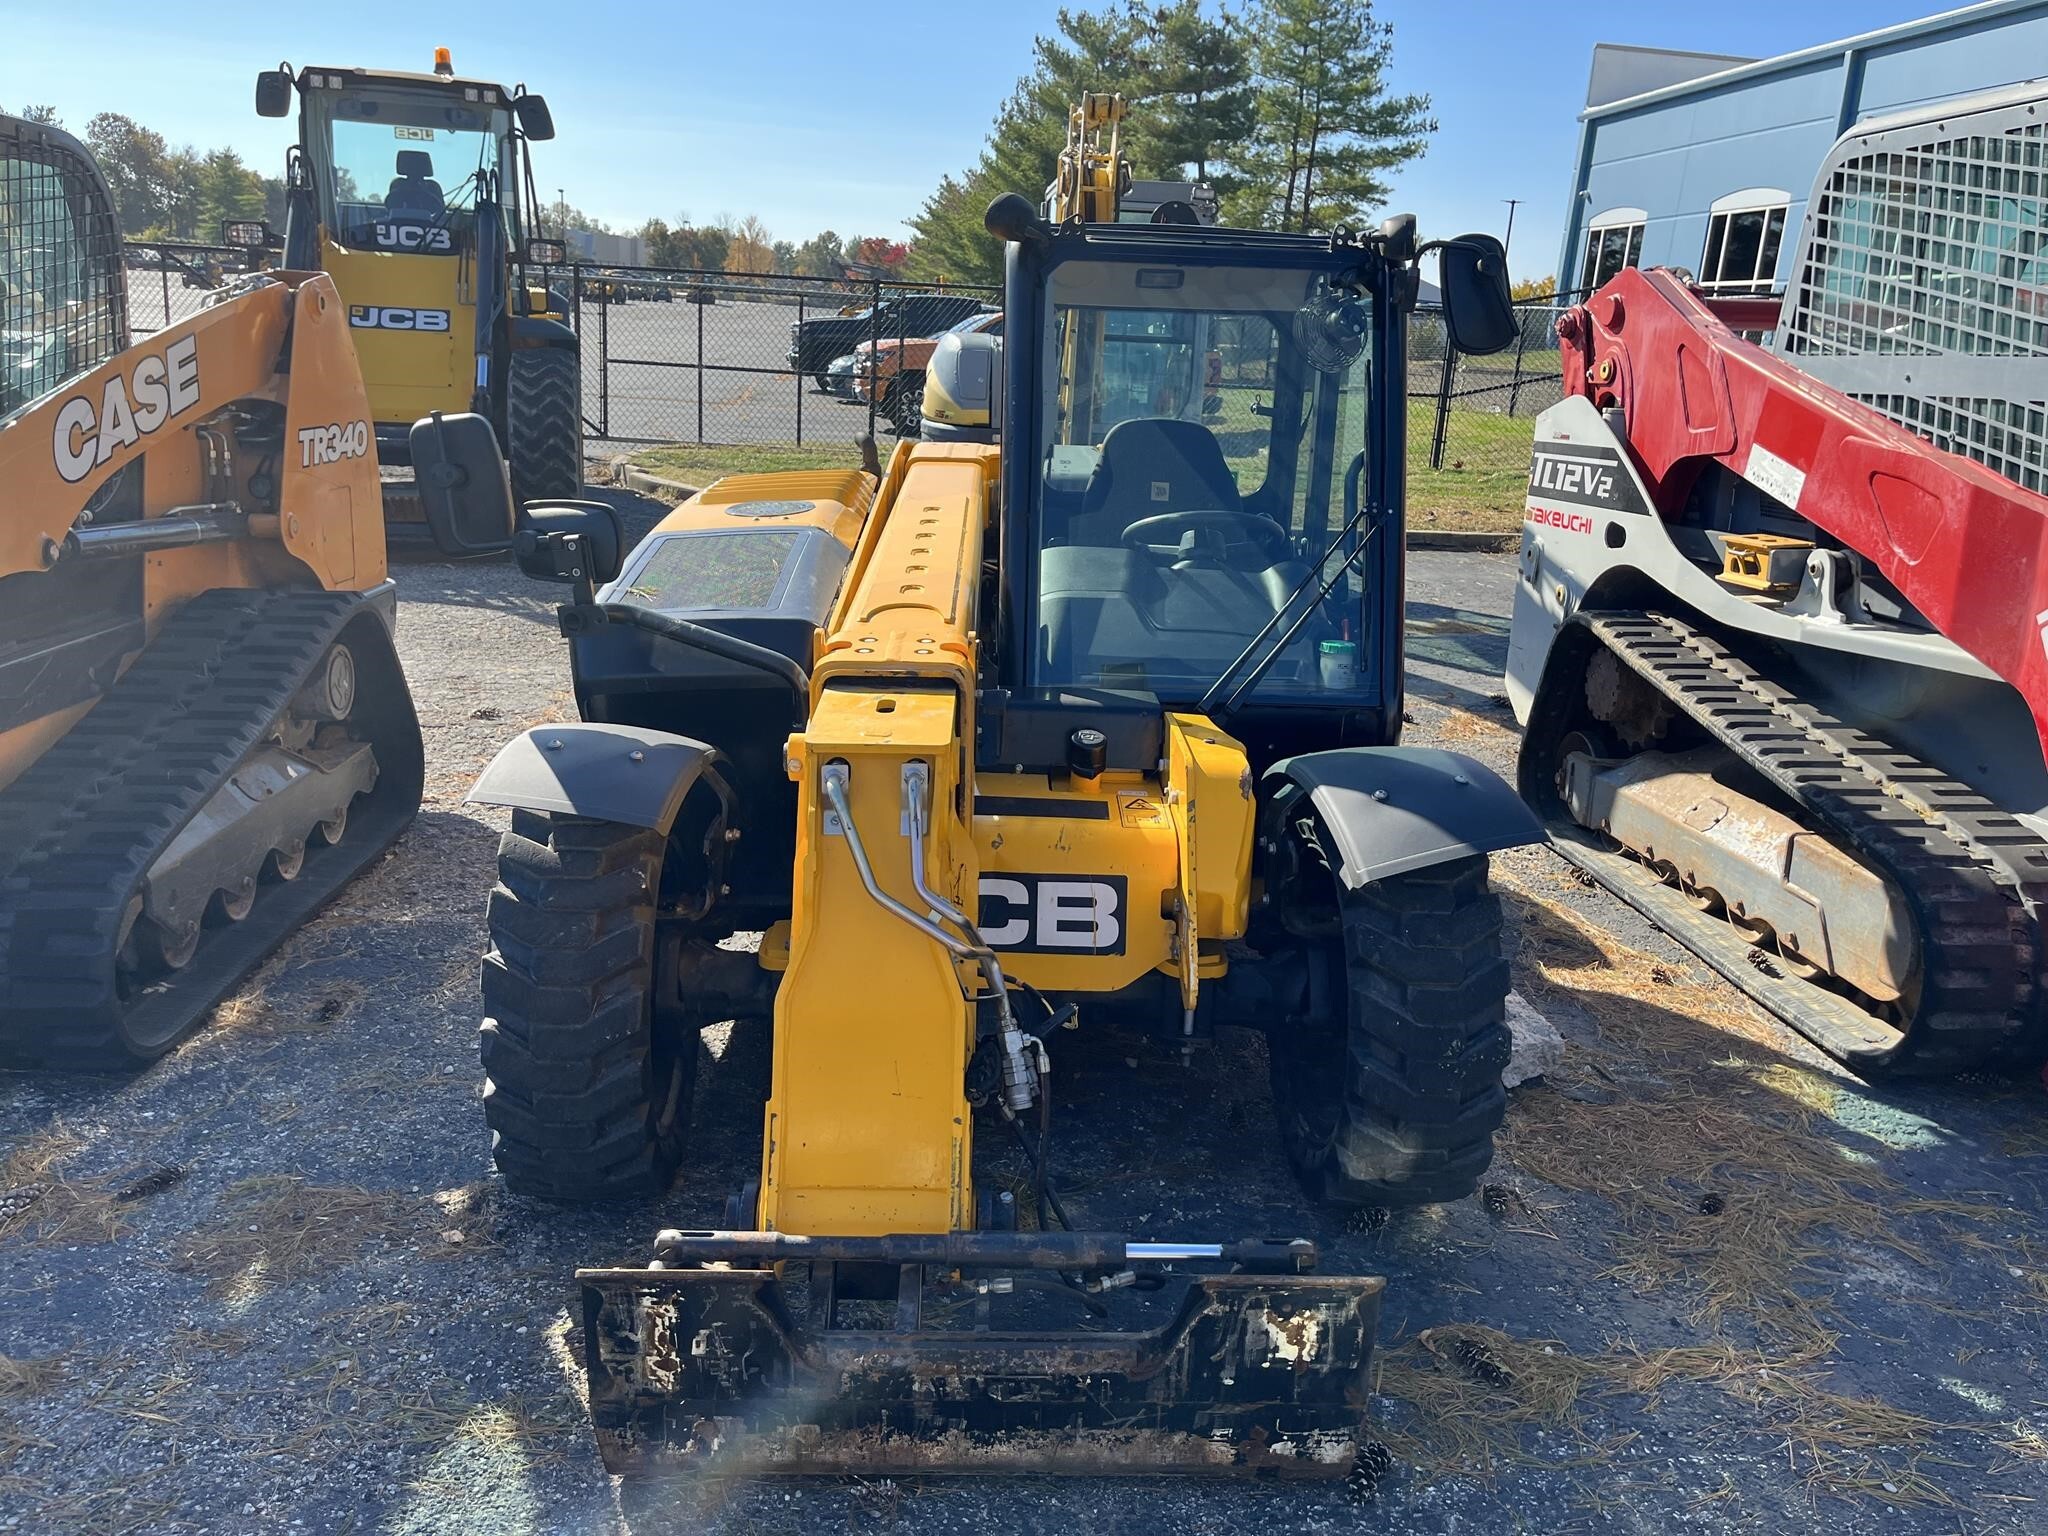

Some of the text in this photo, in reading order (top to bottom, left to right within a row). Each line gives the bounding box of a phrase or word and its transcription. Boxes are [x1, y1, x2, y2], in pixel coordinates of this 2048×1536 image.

[376, 224, 451, 249] JCB
[351, 307, 449, 331] JCB
[53, 334, 200, 482] CASE
[299, 420, 367, 468] TR340
[978, 878, 1120, 948] CB
